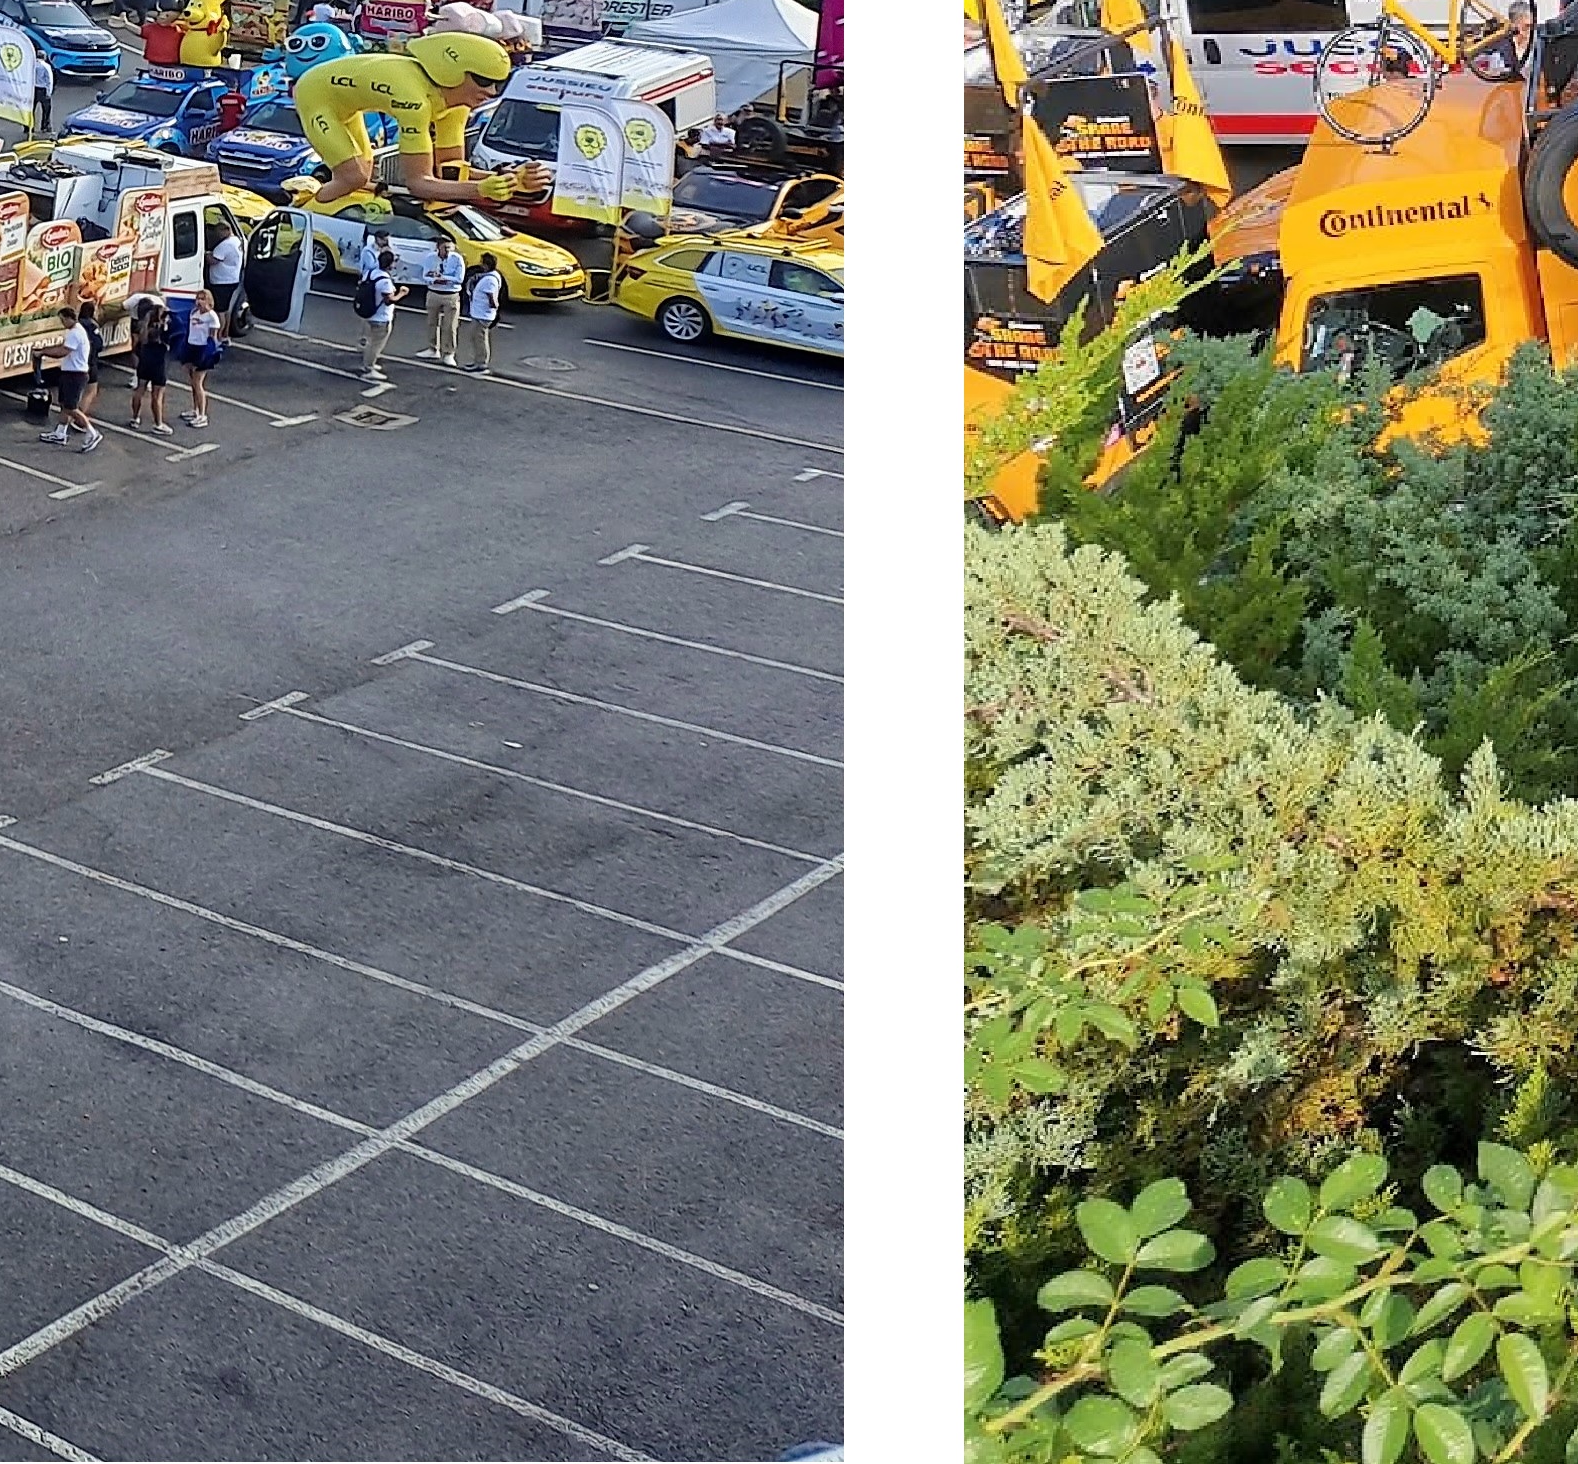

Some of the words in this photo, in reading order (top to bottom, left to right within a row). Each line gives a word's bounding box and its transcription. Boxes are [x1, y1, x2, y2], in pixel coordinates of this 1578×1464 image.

[366, 4, 415, 21] HARIBO
[445, 46, 460, 63] LCL
[331, 76, 358, 88] LCL
[370, 81, 395, 96] LCL
[527, 75, 613, 93] JUSSIEU
[190, 123, 218, 145] HARI
[401, 126, 422, 135] LCL
[1319, 195, 1471, 238] Continental
[47, 250, 72, 272] BIO
[3, 340, 33, 369] C'EST
